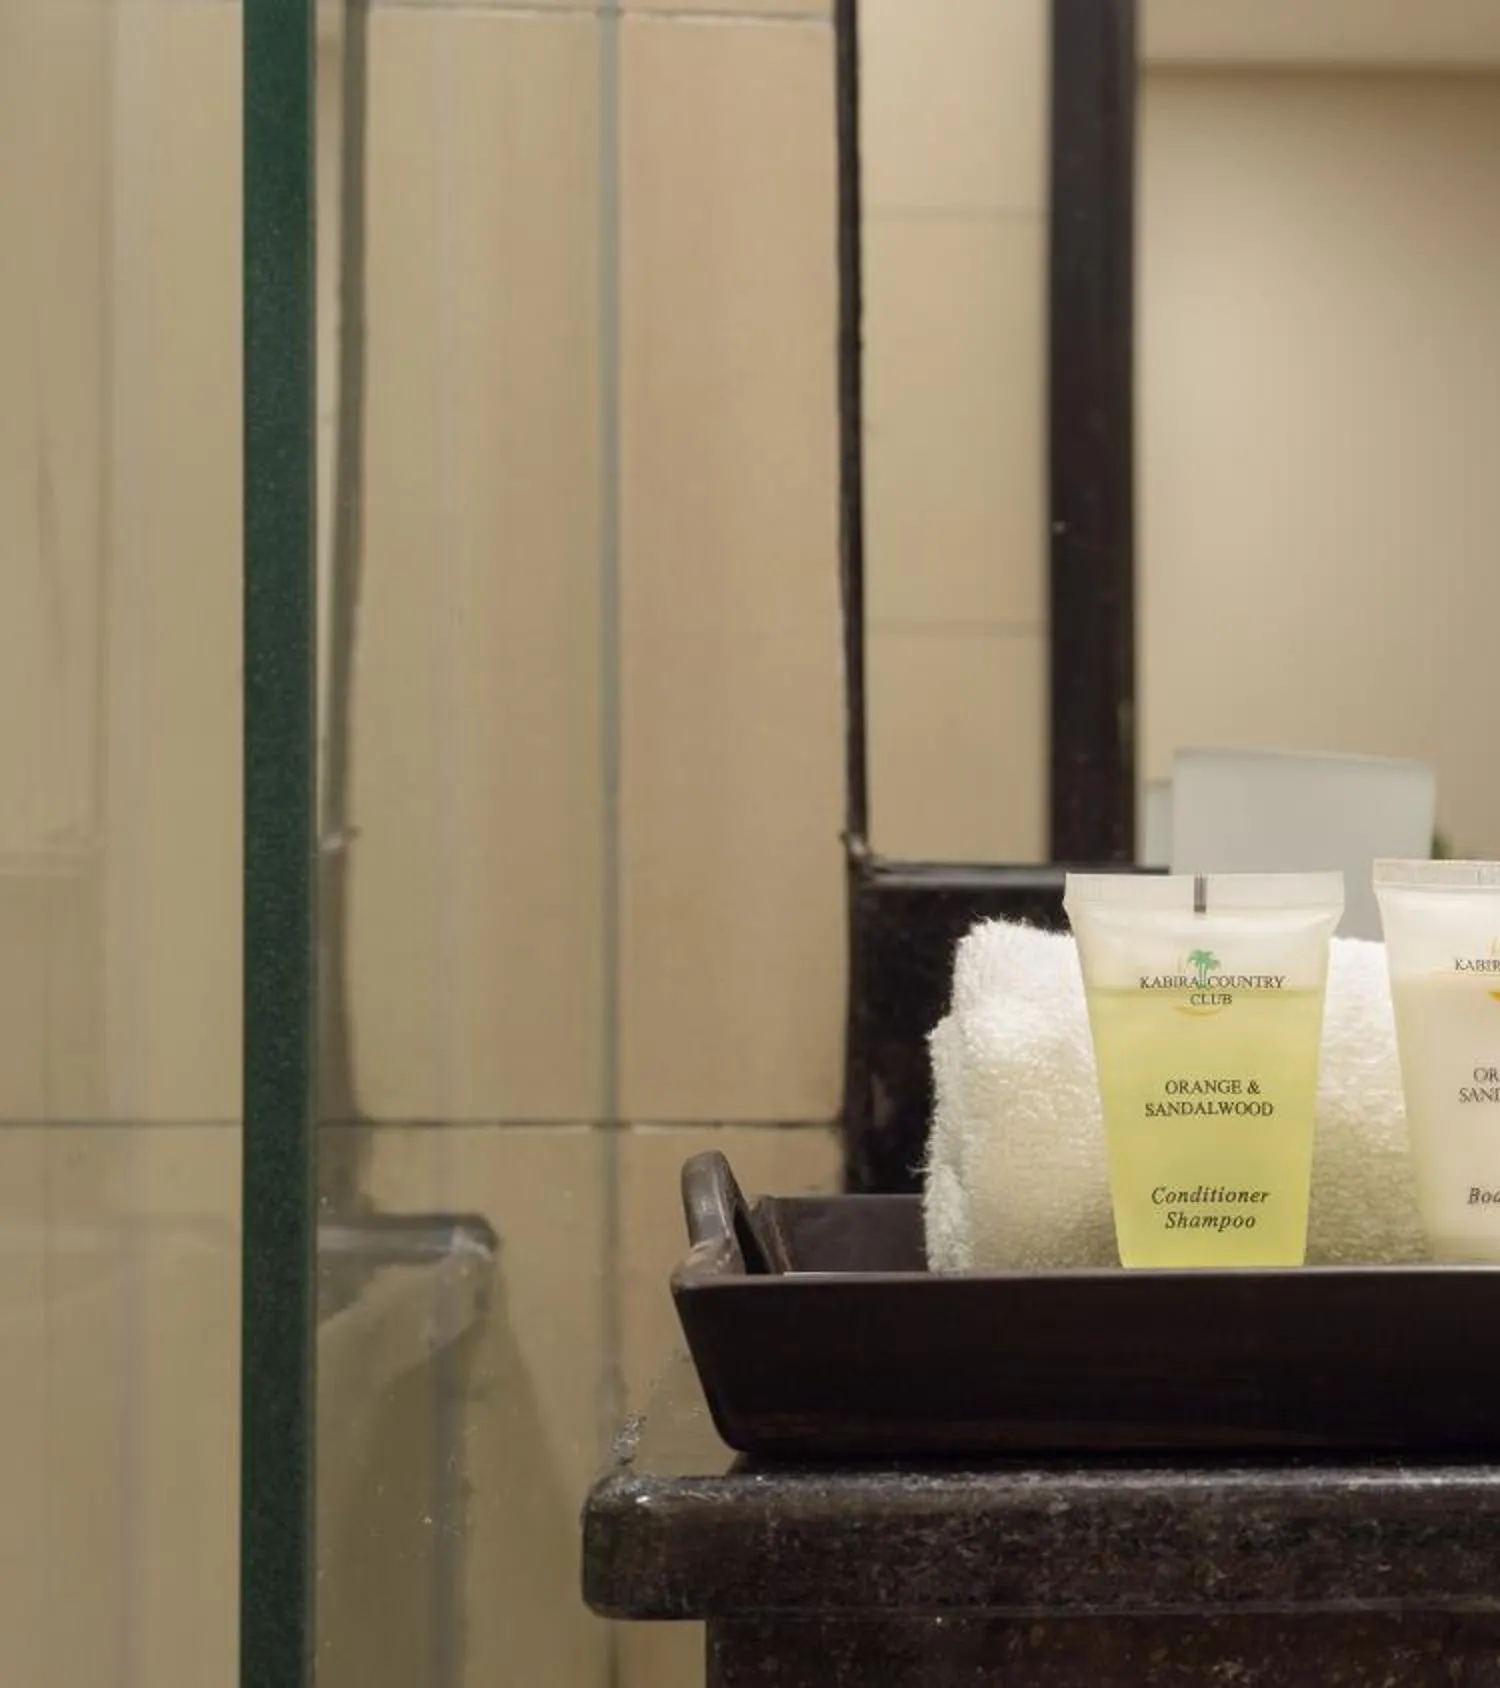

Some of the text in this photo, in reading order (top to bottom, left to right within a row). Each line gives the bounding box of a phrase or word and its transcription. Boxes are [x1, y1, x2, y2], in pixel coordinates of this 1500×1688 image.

[1140, 976, 1288, 989] KABIRA COUNTRY
[1190, 994, 1233, 1006] CLUB
[1165, 1080, 1261, 1095] ORANGE &
[1145, 1102, 1274, 1118] SANDALWOOD
[1151, 1186, 1270, 1204] Conditioner
[1165, 1212, 1256, 1233] Shampoo
